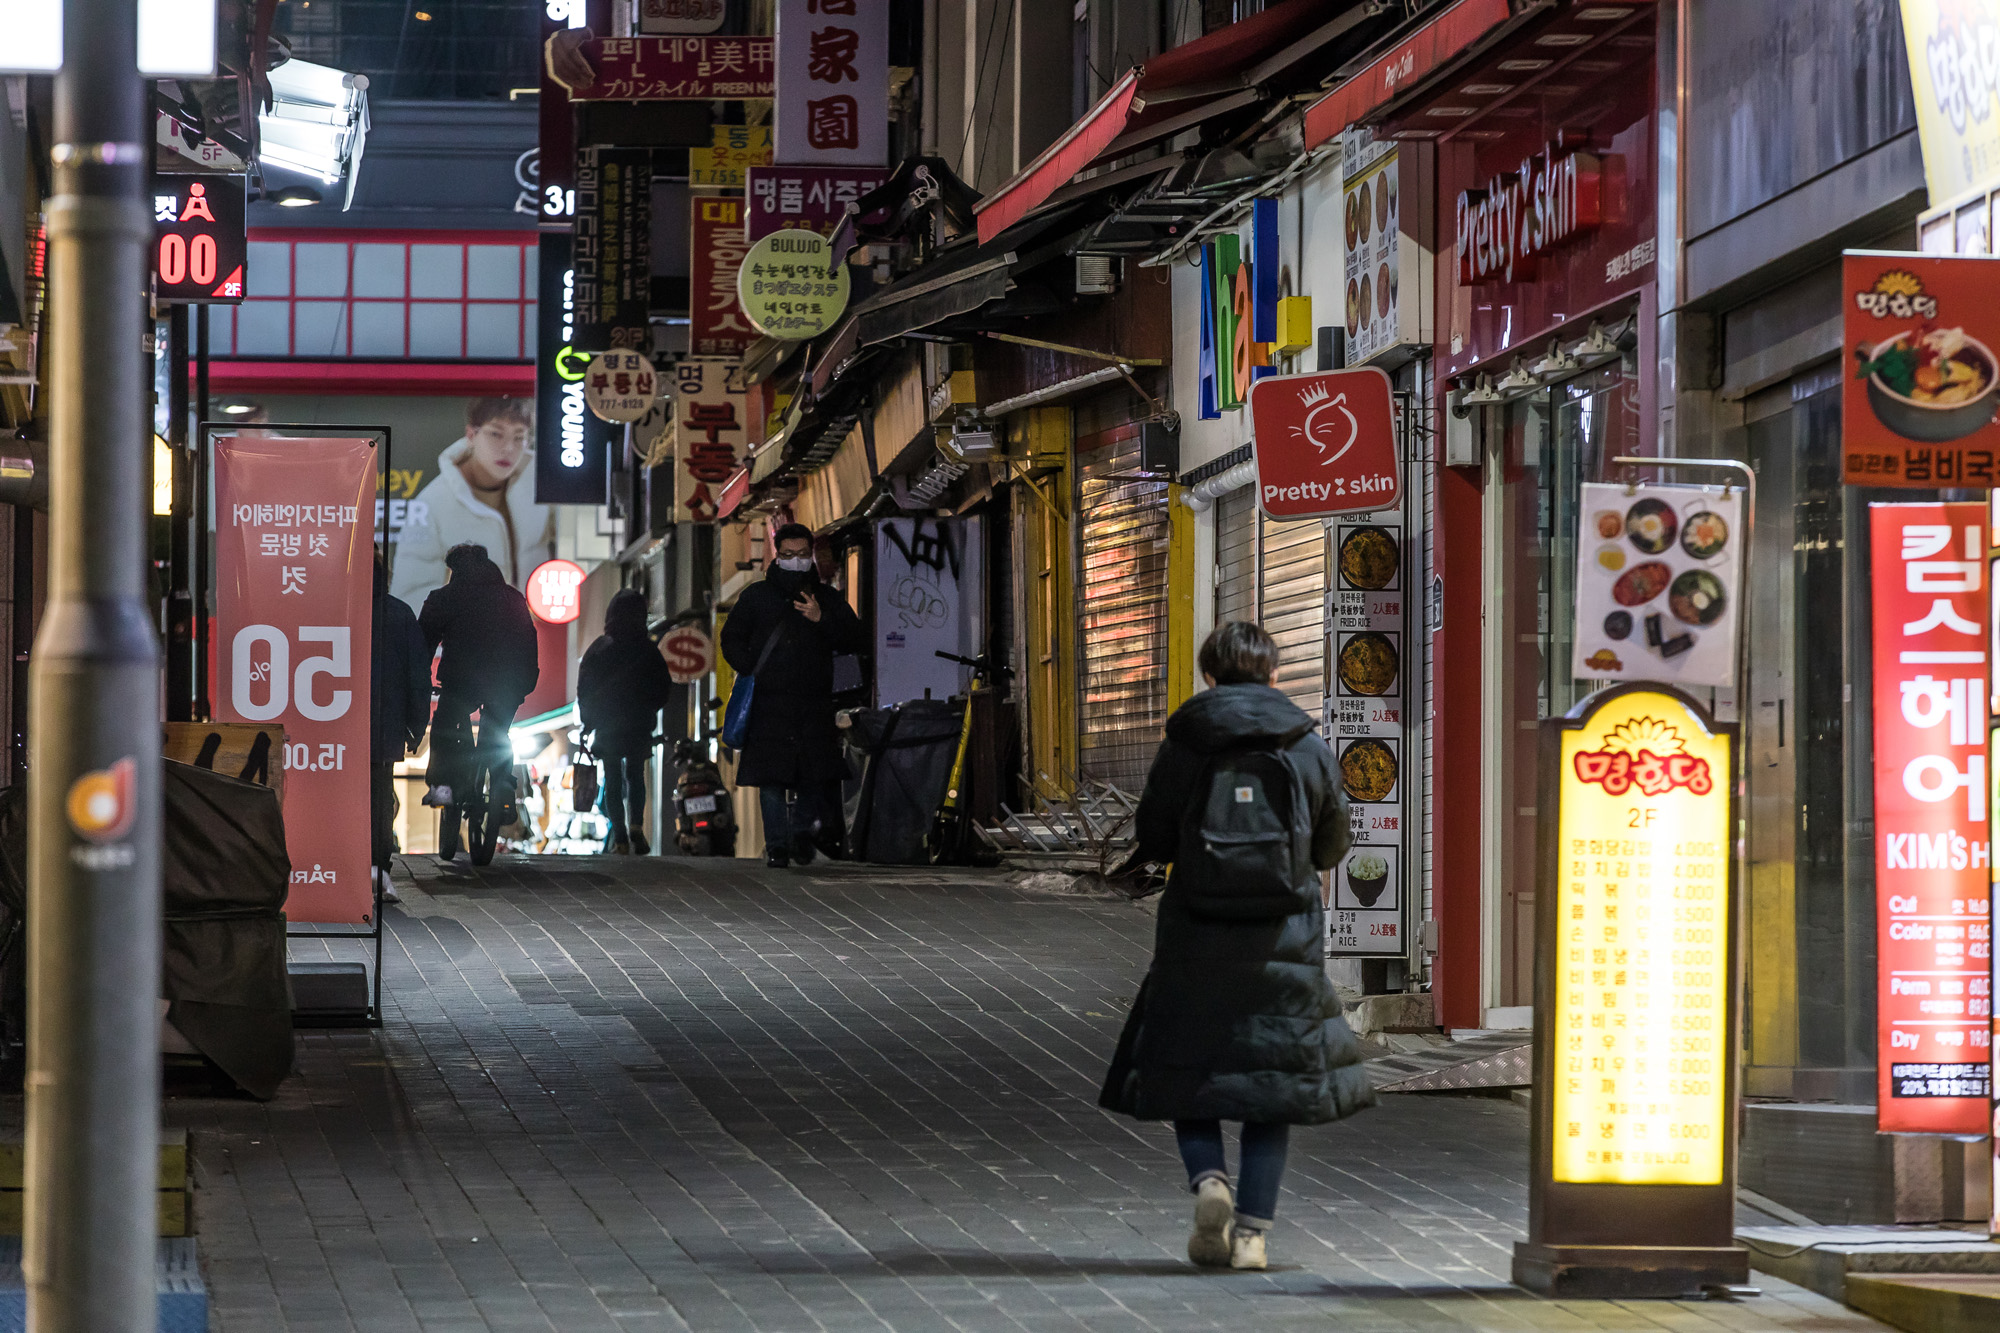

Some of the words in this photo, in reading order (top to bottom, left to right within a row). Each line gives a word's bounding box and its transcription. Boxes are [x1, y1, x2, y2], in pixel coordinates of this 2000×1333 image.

[602, 38, 645, 77] 프린
[658, 38, 711, 77] 네일
[603, 78, 705, 97] プリンネイル
[202, 147, 222, 161] 5F
[543, 185, 575, 216] 31
[1457, 180, 1518, 284] Pretty
[1534, 128, 1577, 251] skin
[224, 282, 241, 297] 2F
[591, 371, 653, 396] 부동산
[560, 381, 585, 468] YOUNG
[1264, 481, 1332, 503] Pretty
[1350, 473, 1394, 495] skin
[1373, 602, 1400, 616] 2人套餐
[1340, 617, 1357, 628] FRIED
[1358, 617, 1371, 628] RICE
[1899, 524, 1986, 822] 킴스헤어
[1372, 709, 1400, 723] 2人套餐
[1339, 724, 1357, 735] FRIED
[1358, 724, 1371, 735] RICE
[1574, 750, 1713, 796] 명화당
[1371, 816, 1399, 830] 2人套餐
[1628, 807, 1658, 828] 2F
[1886, 829, 1968, 871] KIM'S
[1888, 894, 1918, 913] Cut
[1370, 923, 1397, 937] 2人套餐
[1889, 922, 1933, 940] Color
[1338, 936, 1357, 947] RICE
[1891, 1030, 1920, 1050] Dry
